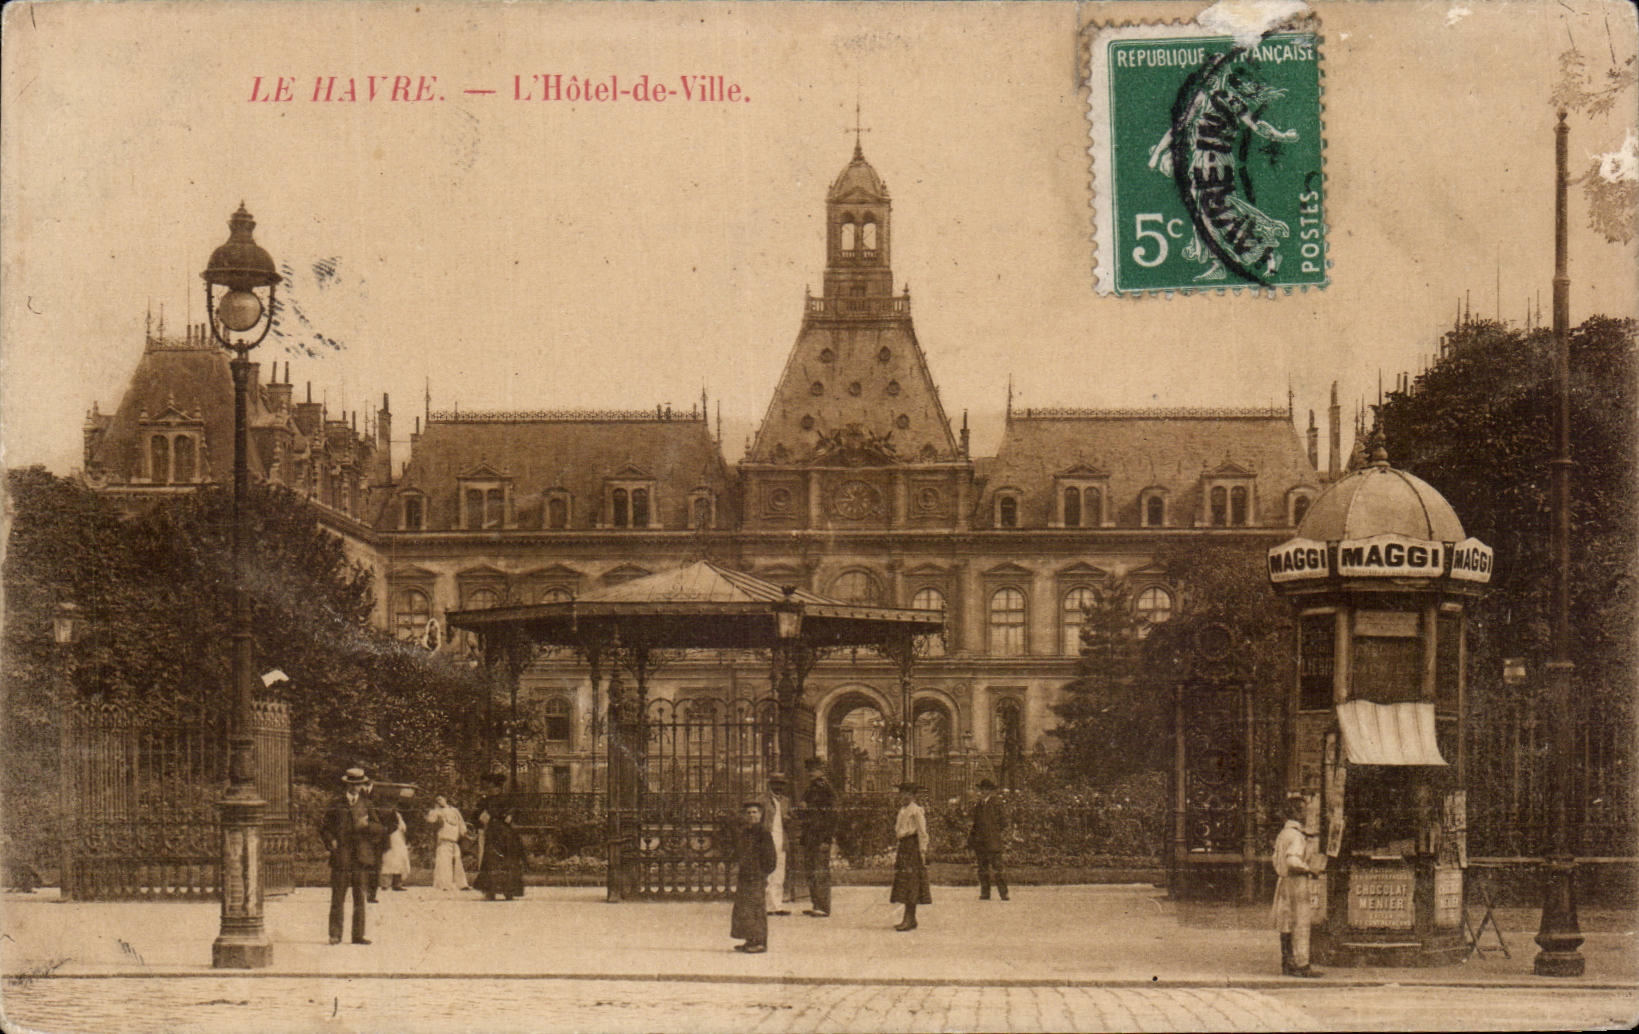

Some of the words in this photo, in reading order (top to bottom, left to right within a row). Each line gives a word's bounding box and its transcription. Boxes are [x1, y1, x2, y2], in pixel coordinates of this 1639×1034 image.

[1233, 44, 1314, 64] RANÇAISE
[1300, 190, 1320, 273] POSTES
[1269, 547, 1326, 574] MAGGI
[1341, 543, 1440, 568] MAGGI
[1453, 547, 1492, 574] MAGGI
[1355, 884, 1407, 896] CHOCOLAT
[1359, 898, 1405, 910] MENIER
